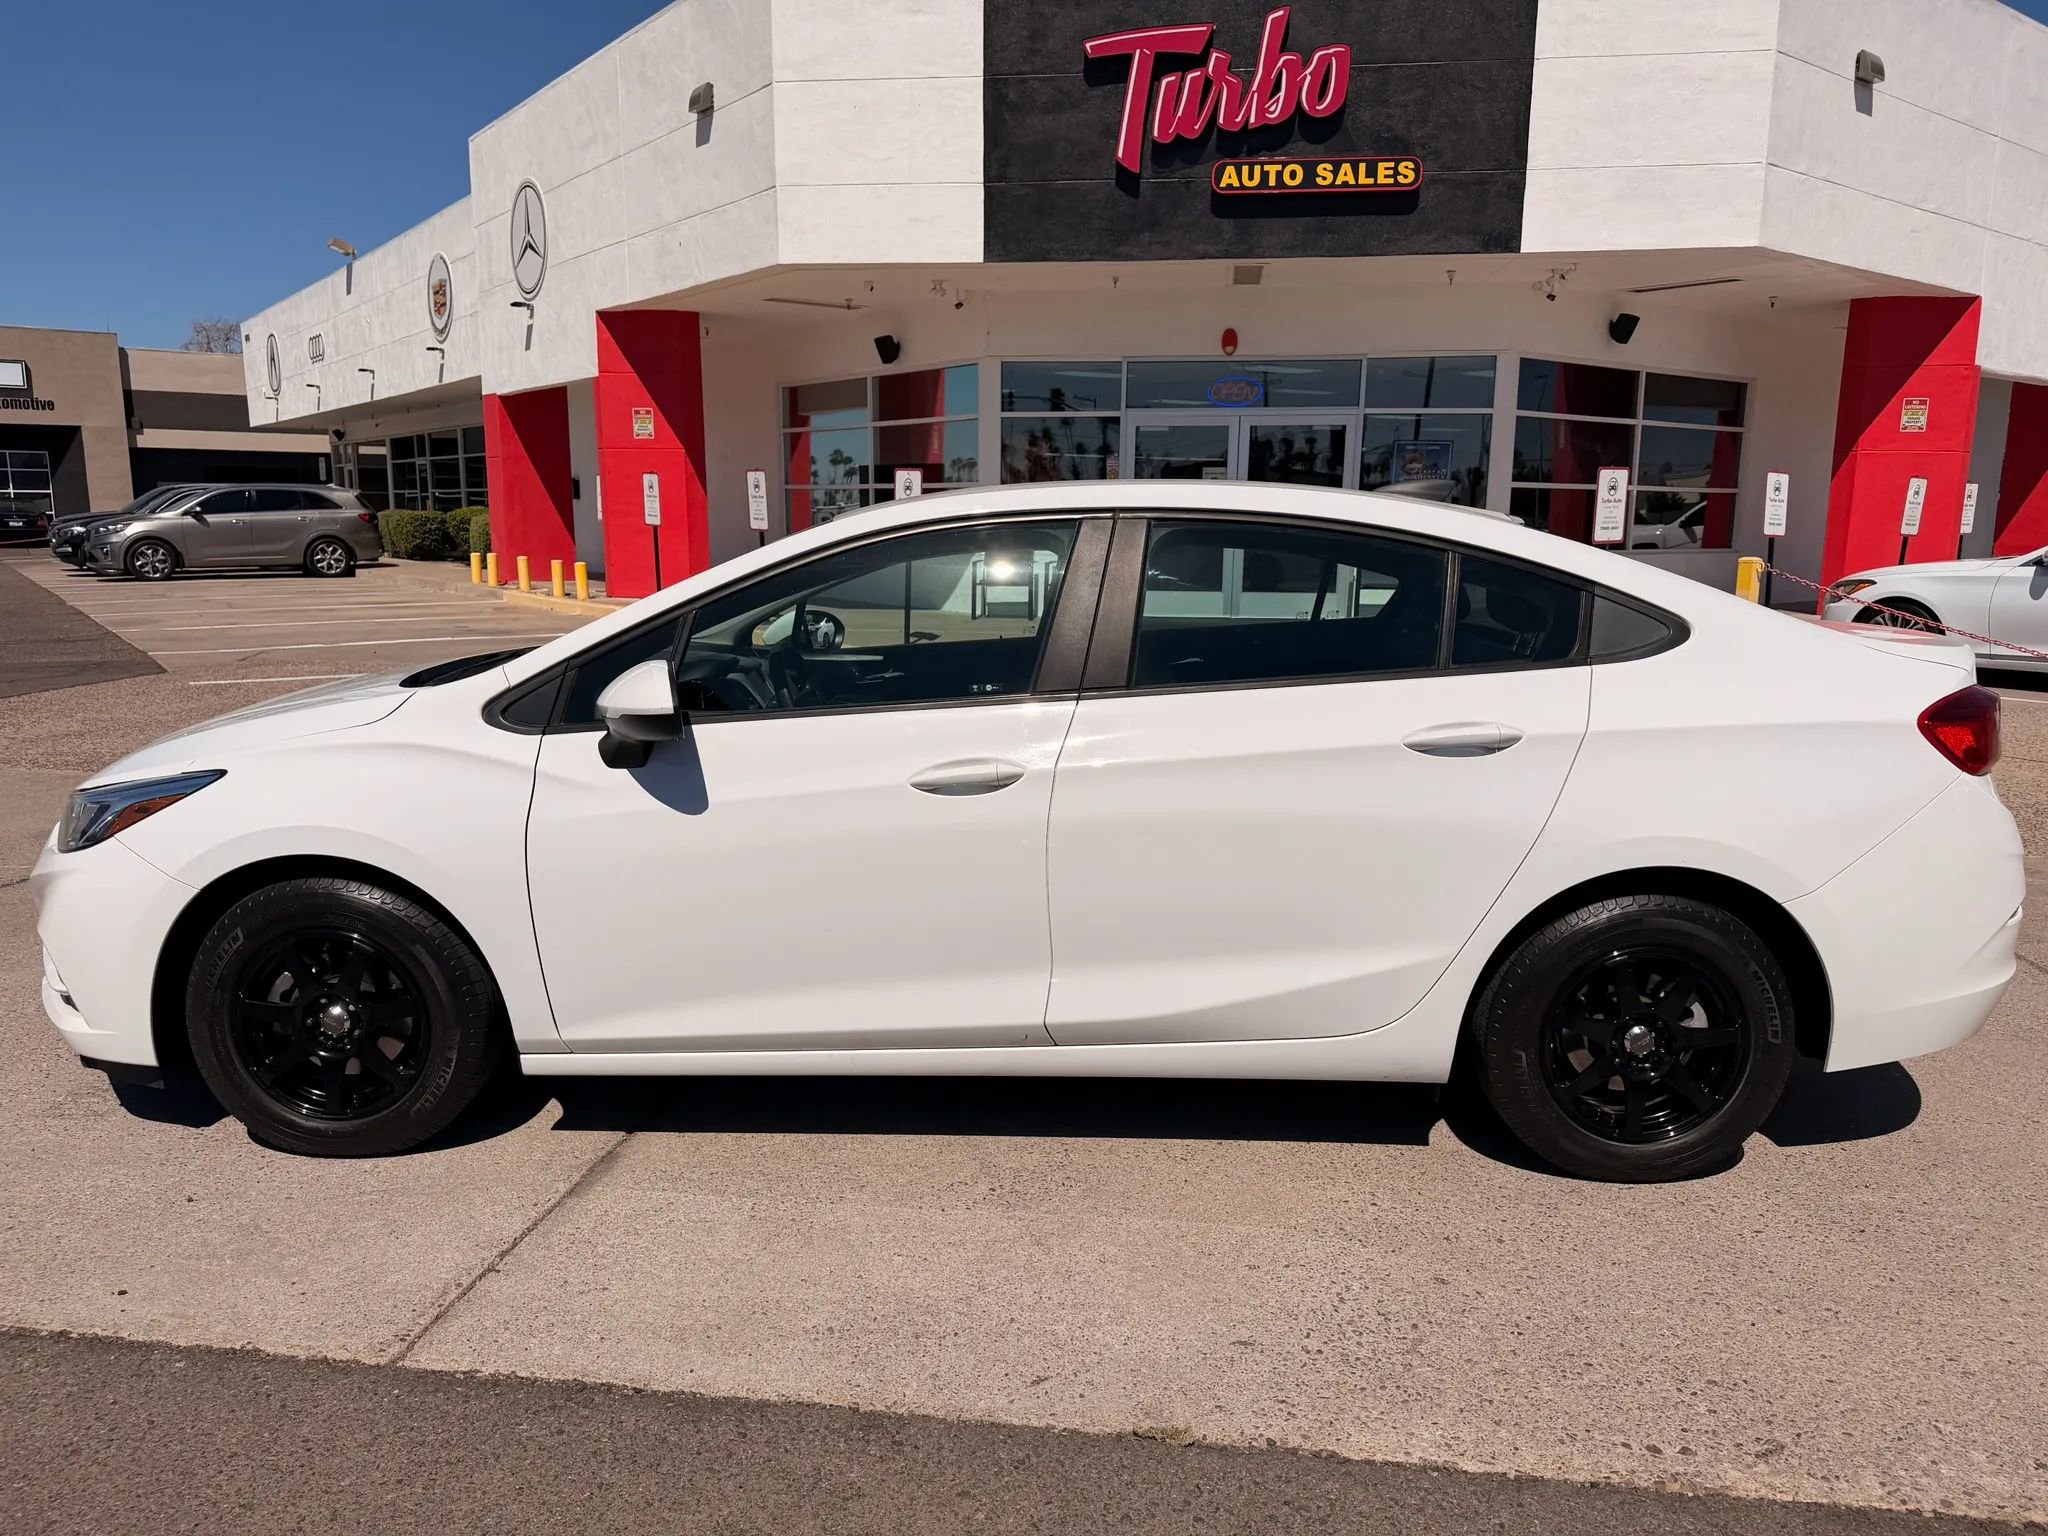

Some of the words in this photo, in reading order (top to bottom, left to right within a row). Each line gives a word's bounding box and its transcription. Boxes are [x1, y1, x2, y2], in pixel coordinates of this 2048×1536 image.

[1083, 5, 1351, 174] Turbo
[1218, 163, 1304, 188] AUTO
[1315, 160, 1416, 186] SALES
[1213, 382, 1258, 400] OPEN
[1752, 969, 1778, 1039] MICHELIN
